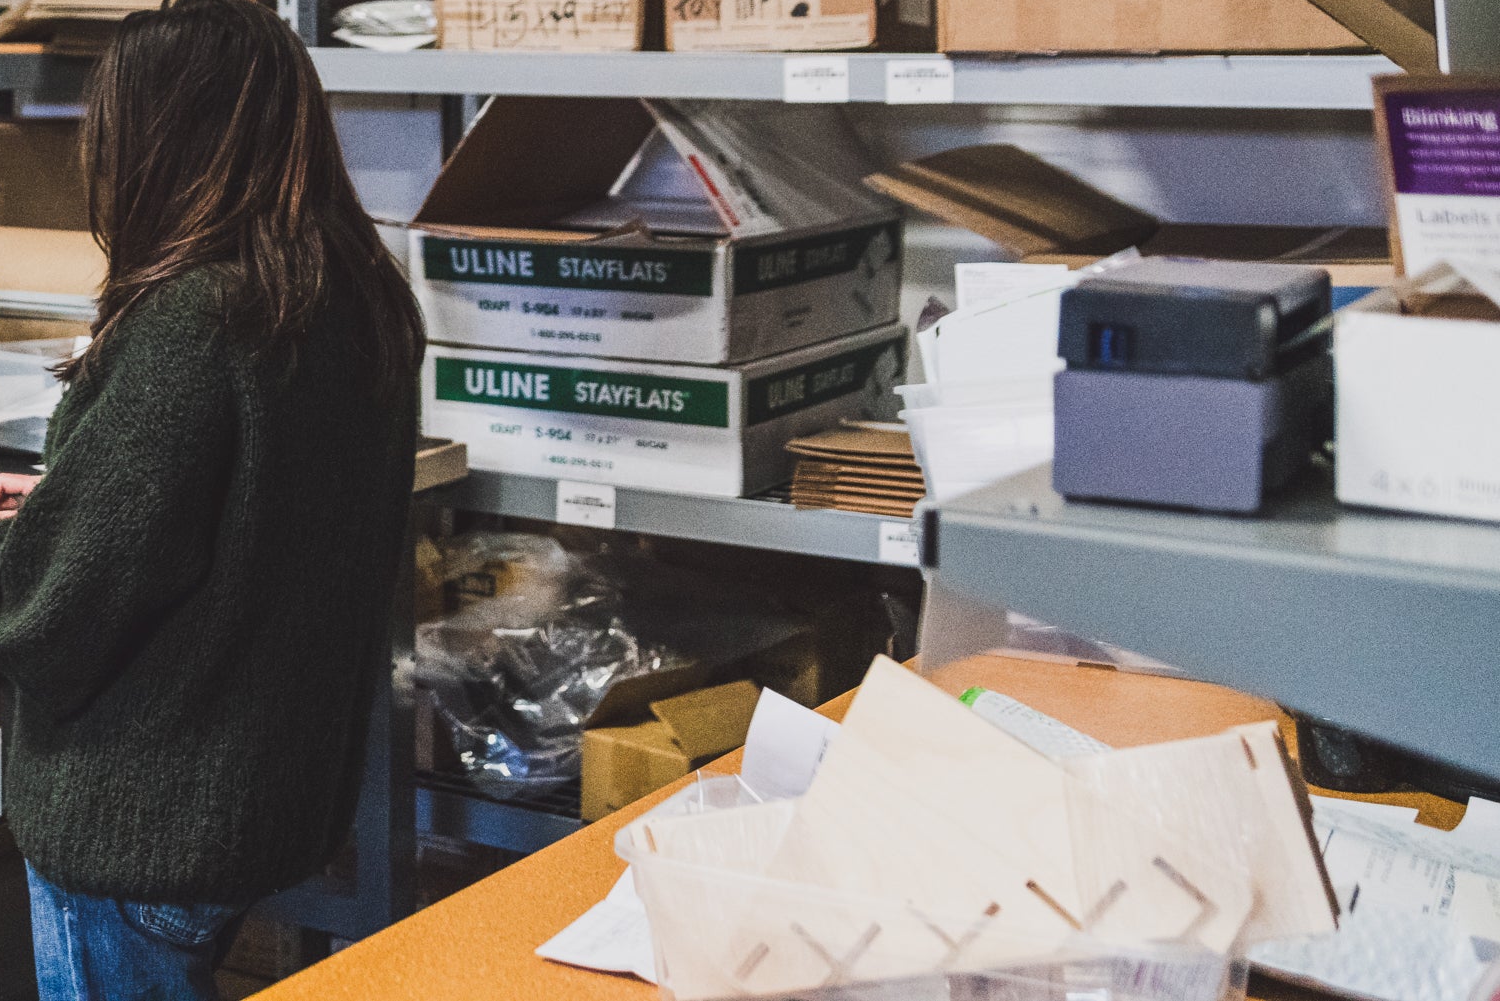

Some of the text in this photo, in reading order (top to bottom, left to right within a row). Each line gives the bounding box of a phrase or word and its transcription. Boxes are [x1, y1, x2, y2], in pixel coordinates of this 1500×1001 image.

[449, 247, 668, 283] ULINE STAYFLATS
[757, 249, 798, 281] ULINE
[465, 367, 685, 412] ULINE STAYFLATS
[767, 374, 807, 409] ULINE
